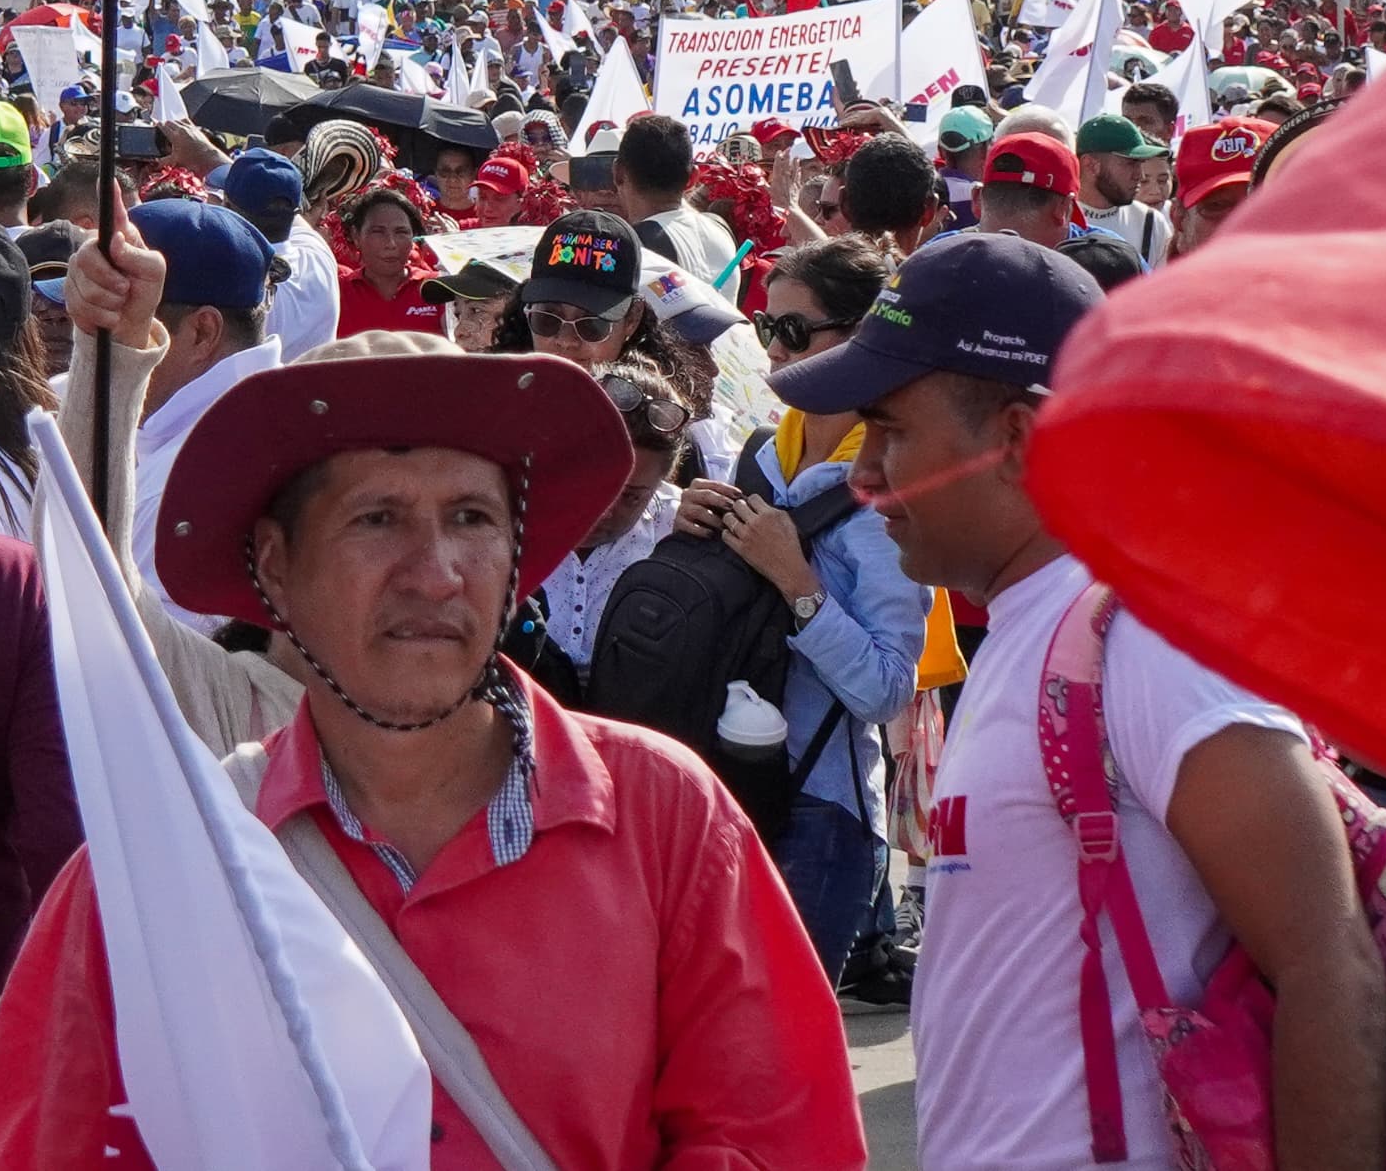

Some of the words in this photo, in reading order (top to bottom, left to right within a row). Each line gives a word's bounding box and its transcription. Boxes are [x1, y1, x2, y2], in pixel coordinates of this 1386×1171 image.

[668, 28, 764, 54] TRANSICION
[768, 15, 862, 50] ENERGETICA
[697, 48, 834, 80] PRESENTE!
[982, 329, 1027, 347] Proyecto
